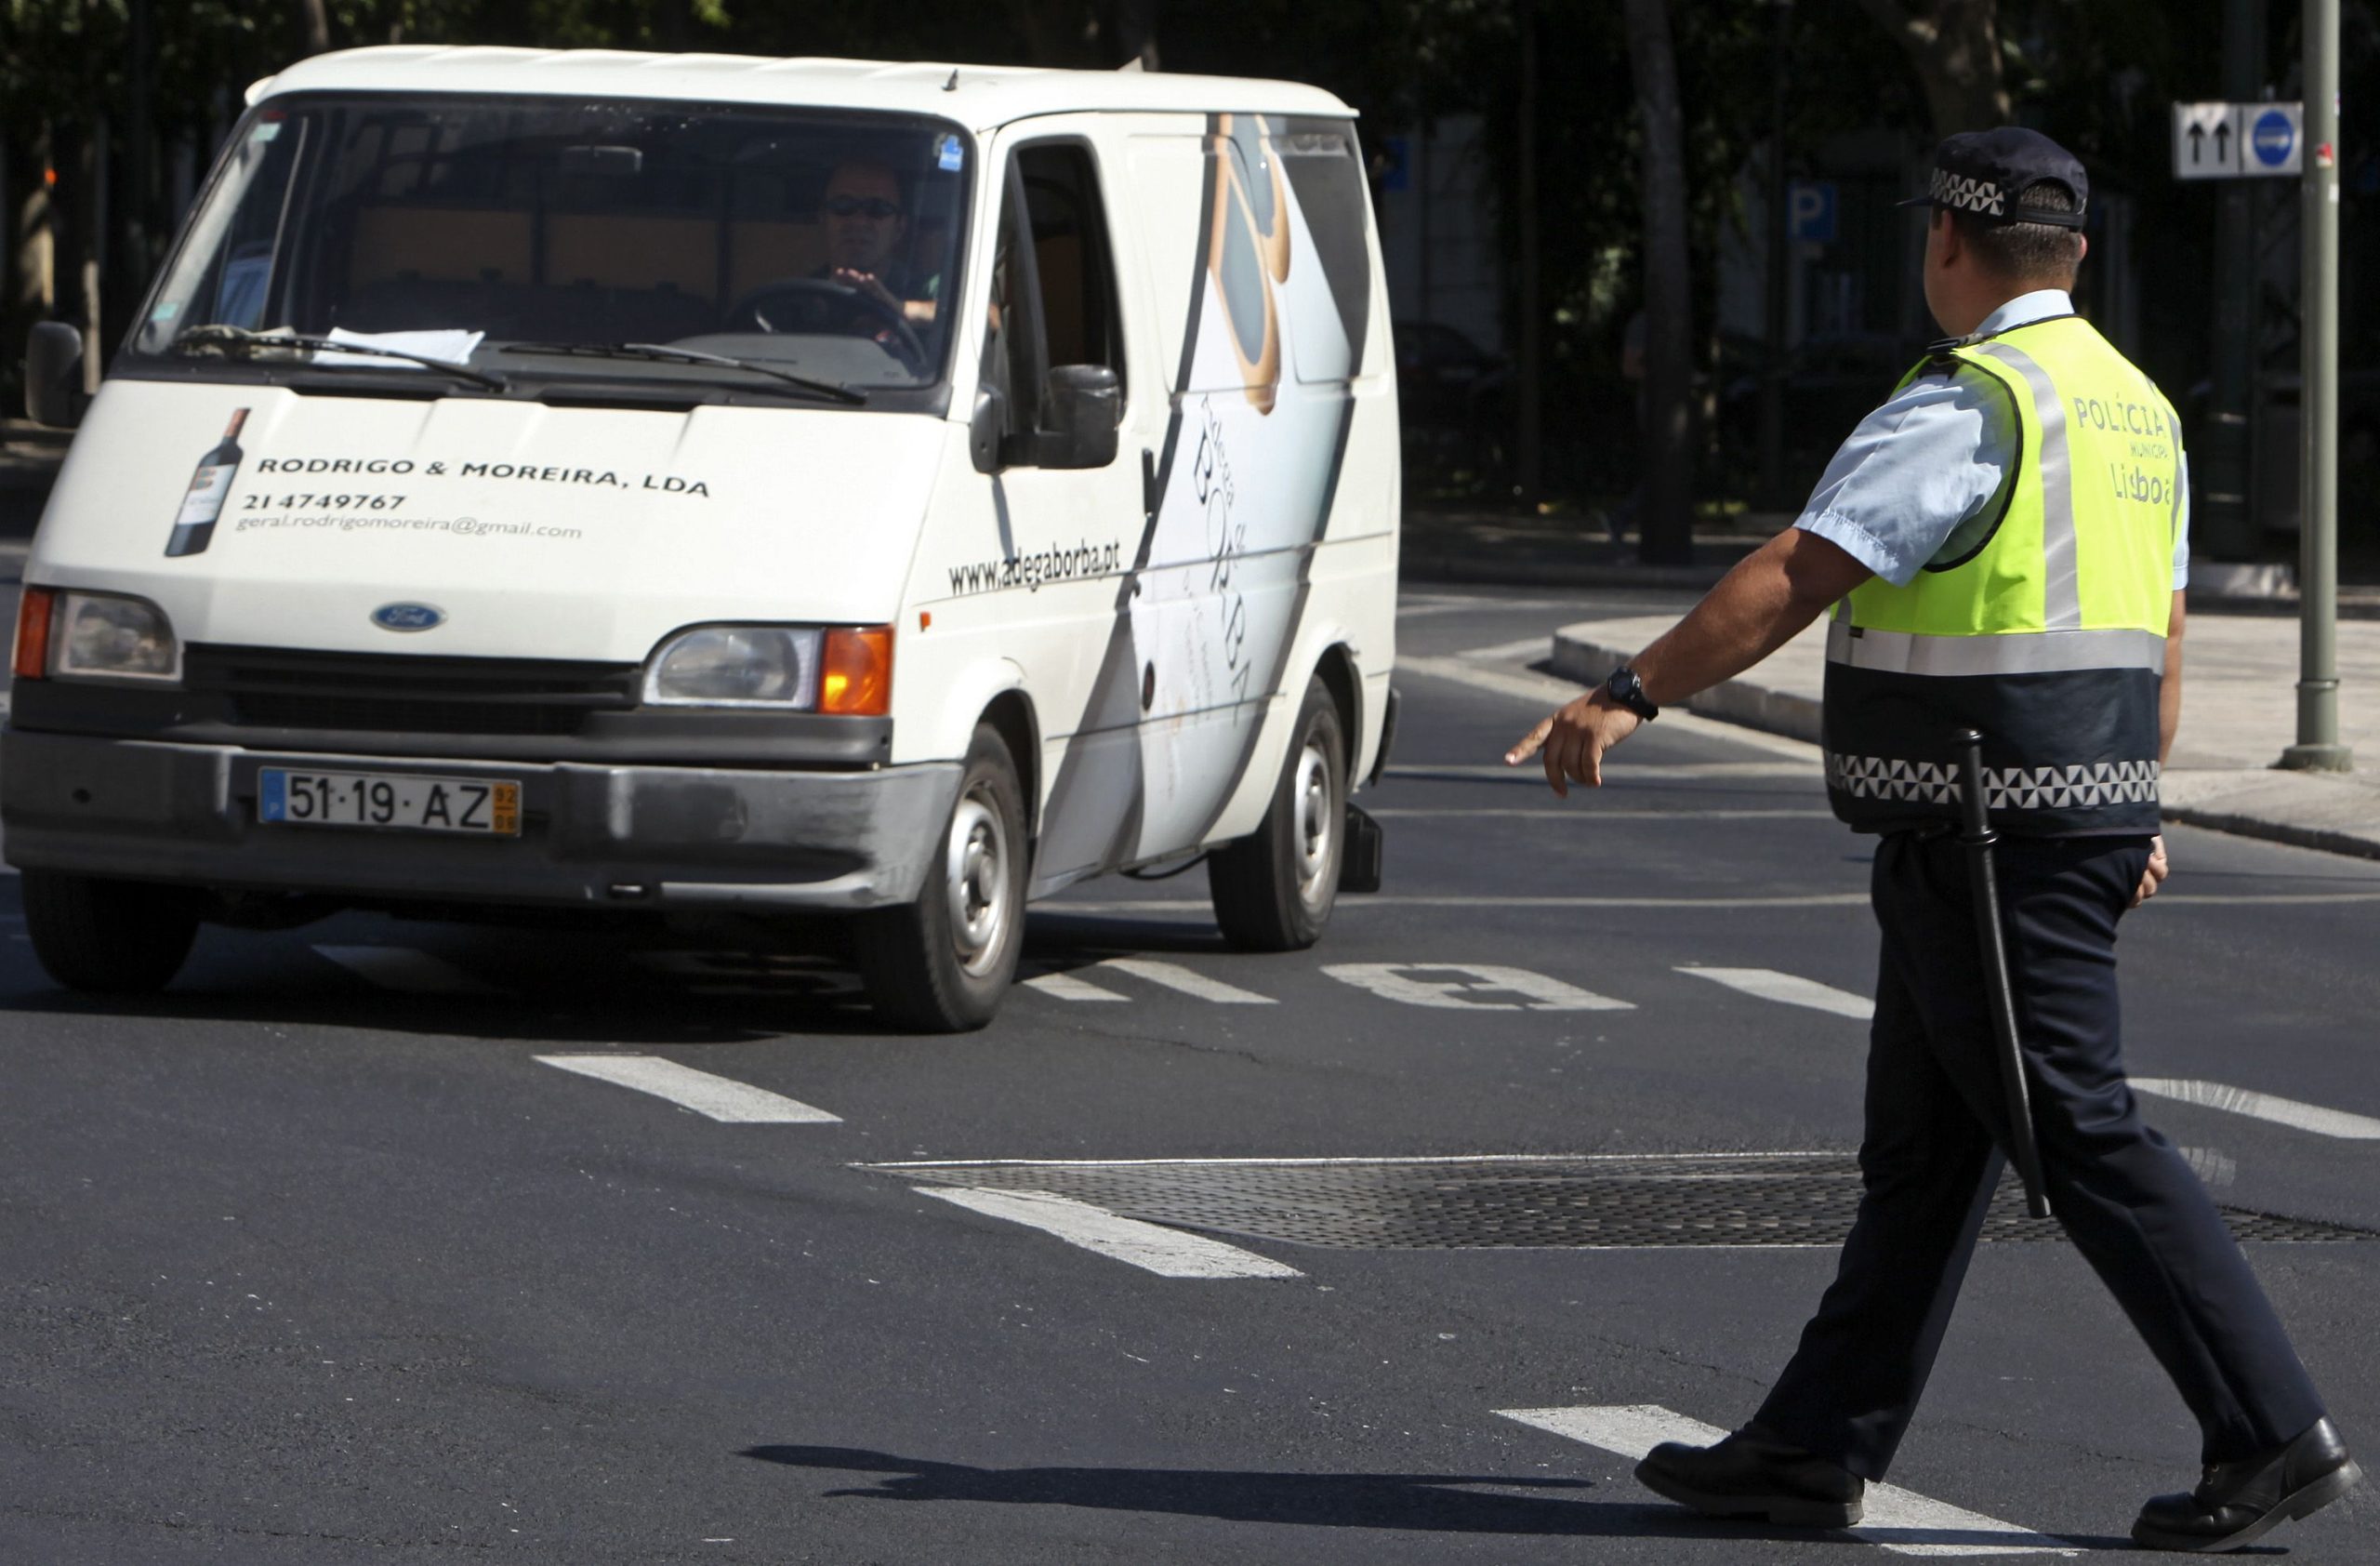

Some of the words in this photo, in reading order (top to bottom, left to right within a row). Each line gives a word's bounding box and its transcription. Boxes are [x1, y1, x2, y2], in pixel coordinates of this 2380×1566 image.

[1791, 189, 1823, 235] P
[258, 458, 414, 474] RODRIGO
[424, 461, 446, 475] &
[461, 462, 628, 489] MOREIRA,
[642, 474, 709, 498] LDA
[235, 515, 582, 540] geral.rodrigomoreira@gmail.com
[948, 537, 1119, 593] www.adegaborba.pt
